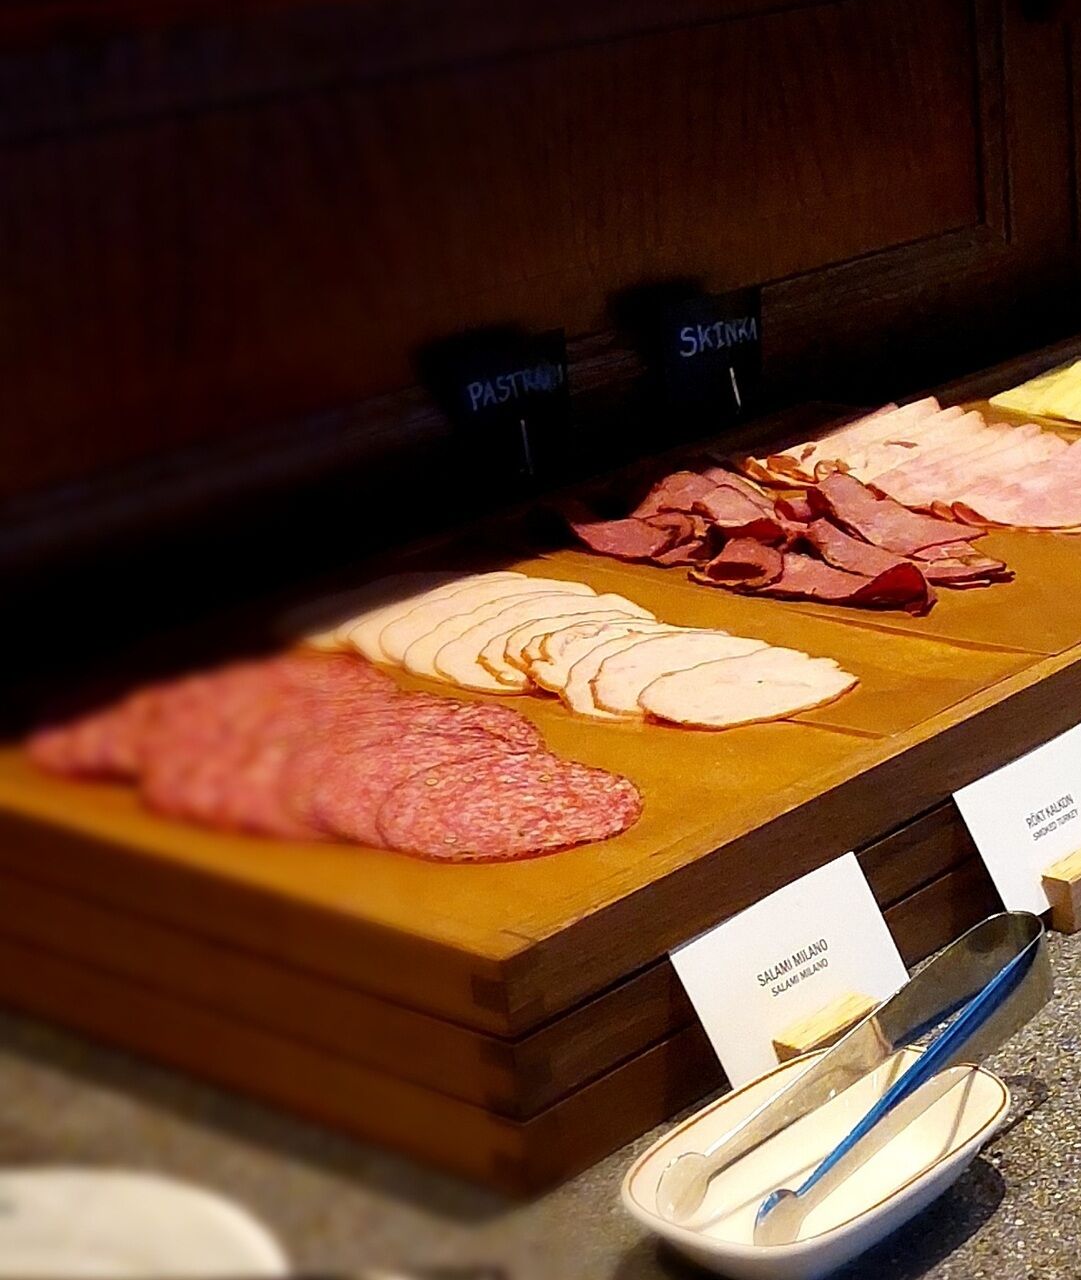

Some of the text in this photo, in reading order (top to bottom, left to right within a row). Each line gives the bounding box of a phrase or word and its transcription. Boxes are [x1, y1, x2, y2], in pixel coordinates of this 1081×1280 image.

[679, 316, 759, 358] SKINKA
[467, 363, 564, 411] PASTRI
[1025, 793, 1075, 829] RÖKT KALKON
[757, 938, 829, 987] SALAMI MILANO
[771, 958, 829, 997] SALAMI MILANO
